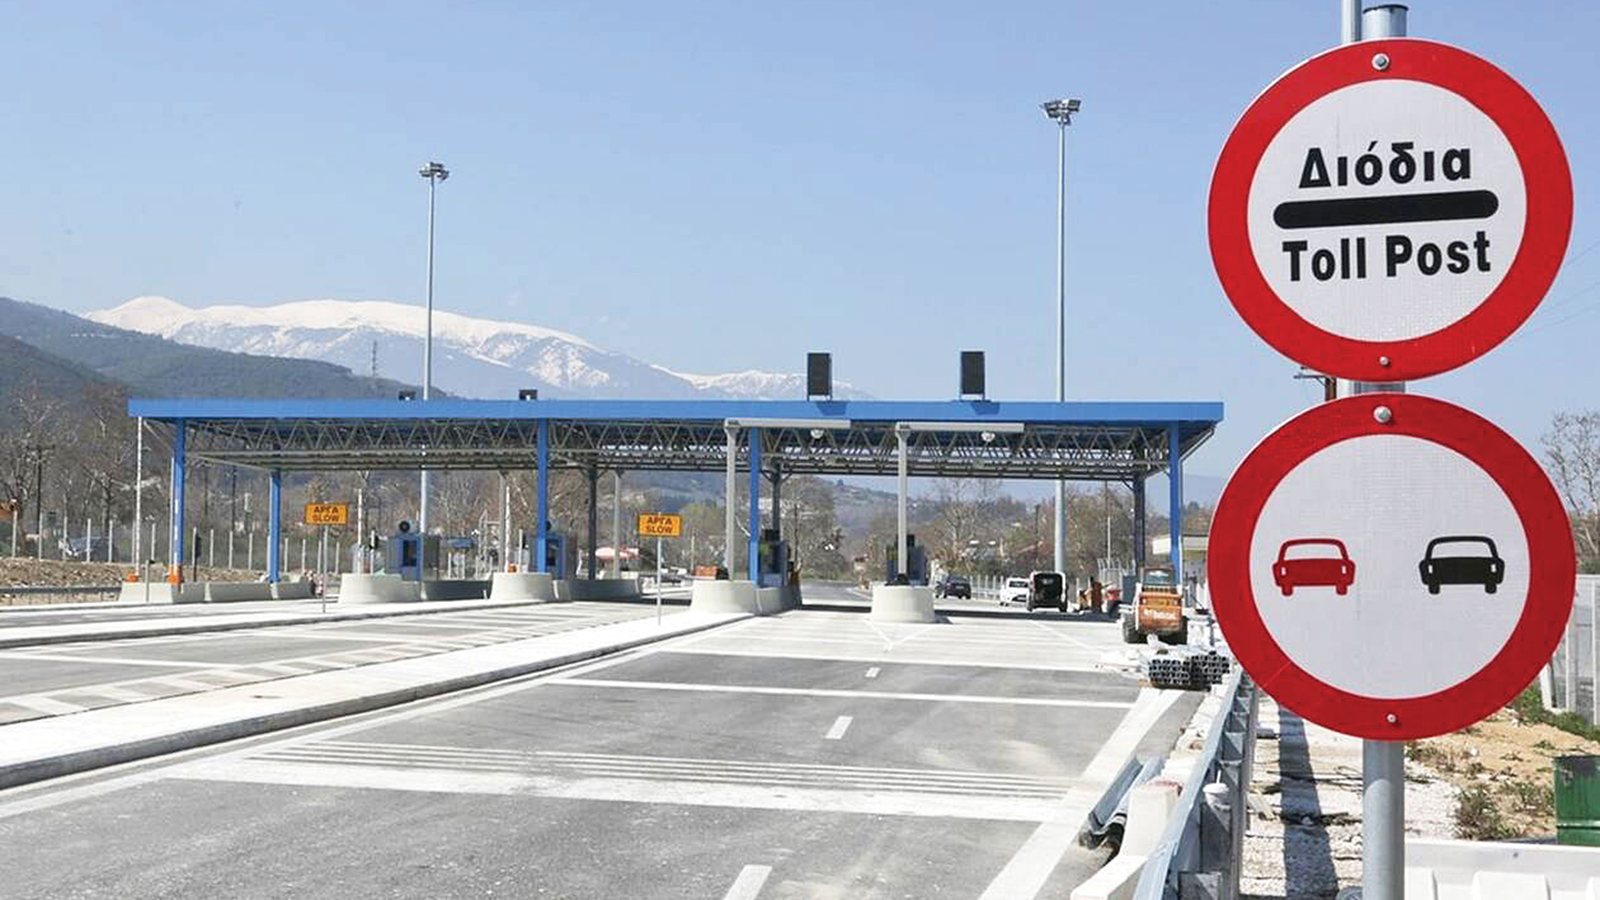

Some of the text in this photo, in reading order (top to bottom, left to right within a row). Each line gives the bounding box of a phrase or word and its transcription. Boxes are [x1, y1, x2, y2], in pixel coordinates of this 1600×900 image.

[1299, 141, 1471, 189] Διόδια
[1282, 231, 1492, 282] Toll Post
[312, 514, 340, 522] SLOW
[645, 525, 673, 533] SLOW
